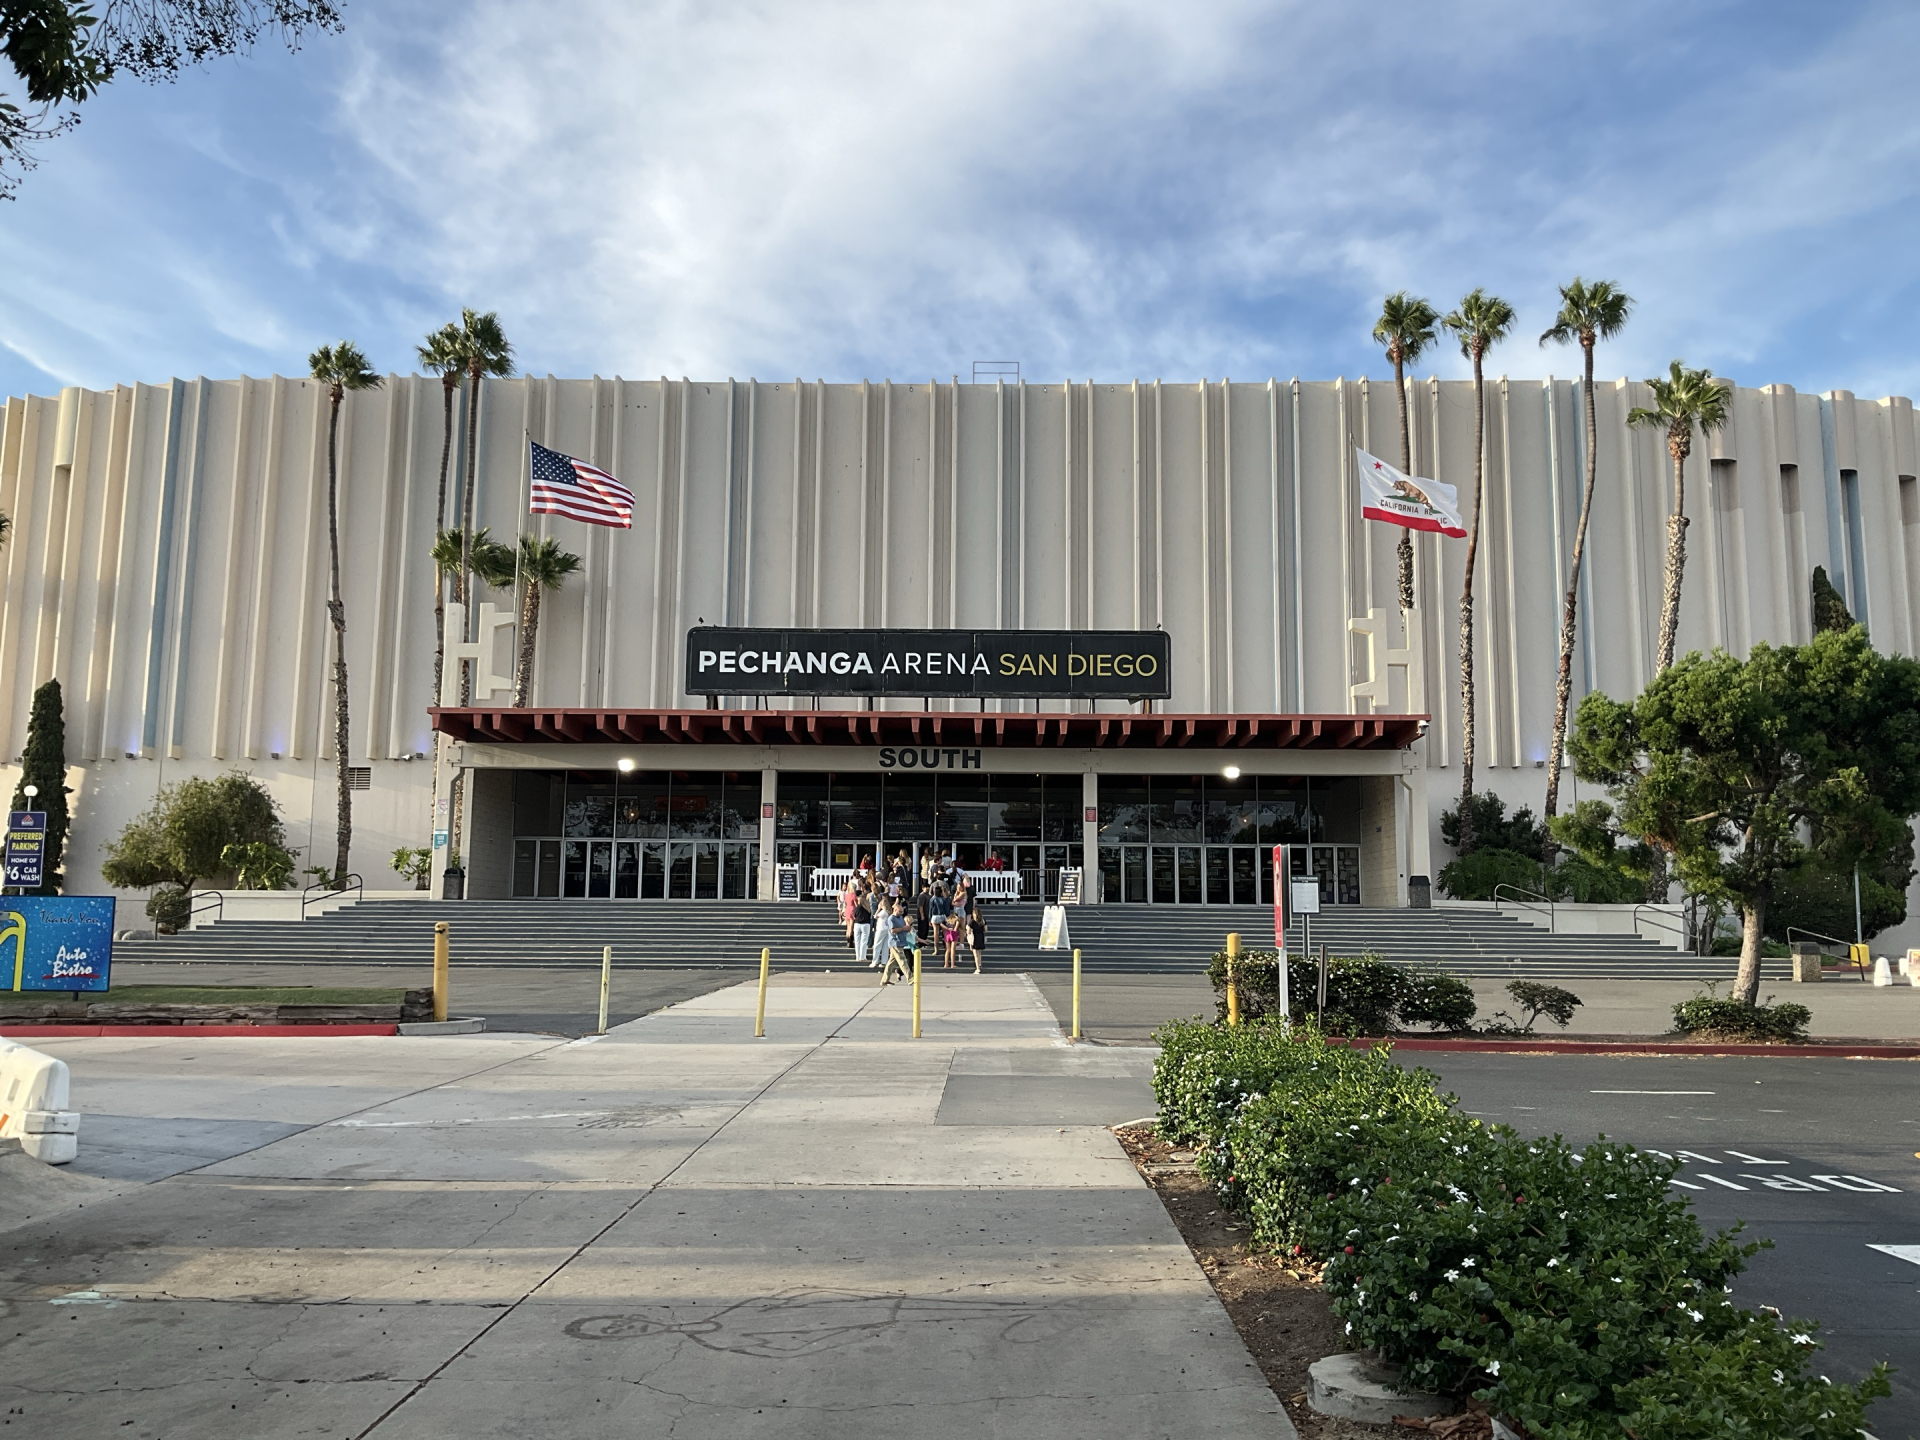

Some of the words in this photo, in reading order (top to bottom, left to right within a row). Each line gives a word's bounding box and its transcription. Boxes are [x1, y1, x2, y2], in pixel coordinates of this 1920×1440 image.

[1380, 499, 1419, 514] CALIFORNIA
[698, 650, 873, 674] PECHANGA
[881, 652, 991, 675] ARENA
[999, 653, 1058, 677] SAN
[1067, 654, 1158, 677] DIEGO
[878, 747, 981, 769] SOUTH
[9, 831, 43, 840] PREFERRED
[11, 842, 39, 851] PARKING
[6, 866, 19, 880] $6
[40, 910, 74, 923] Thank
[79, 912, 100, 924] You
[56, 945, 87, 962] Auto
[52, 961, 93, 978] Bistro
